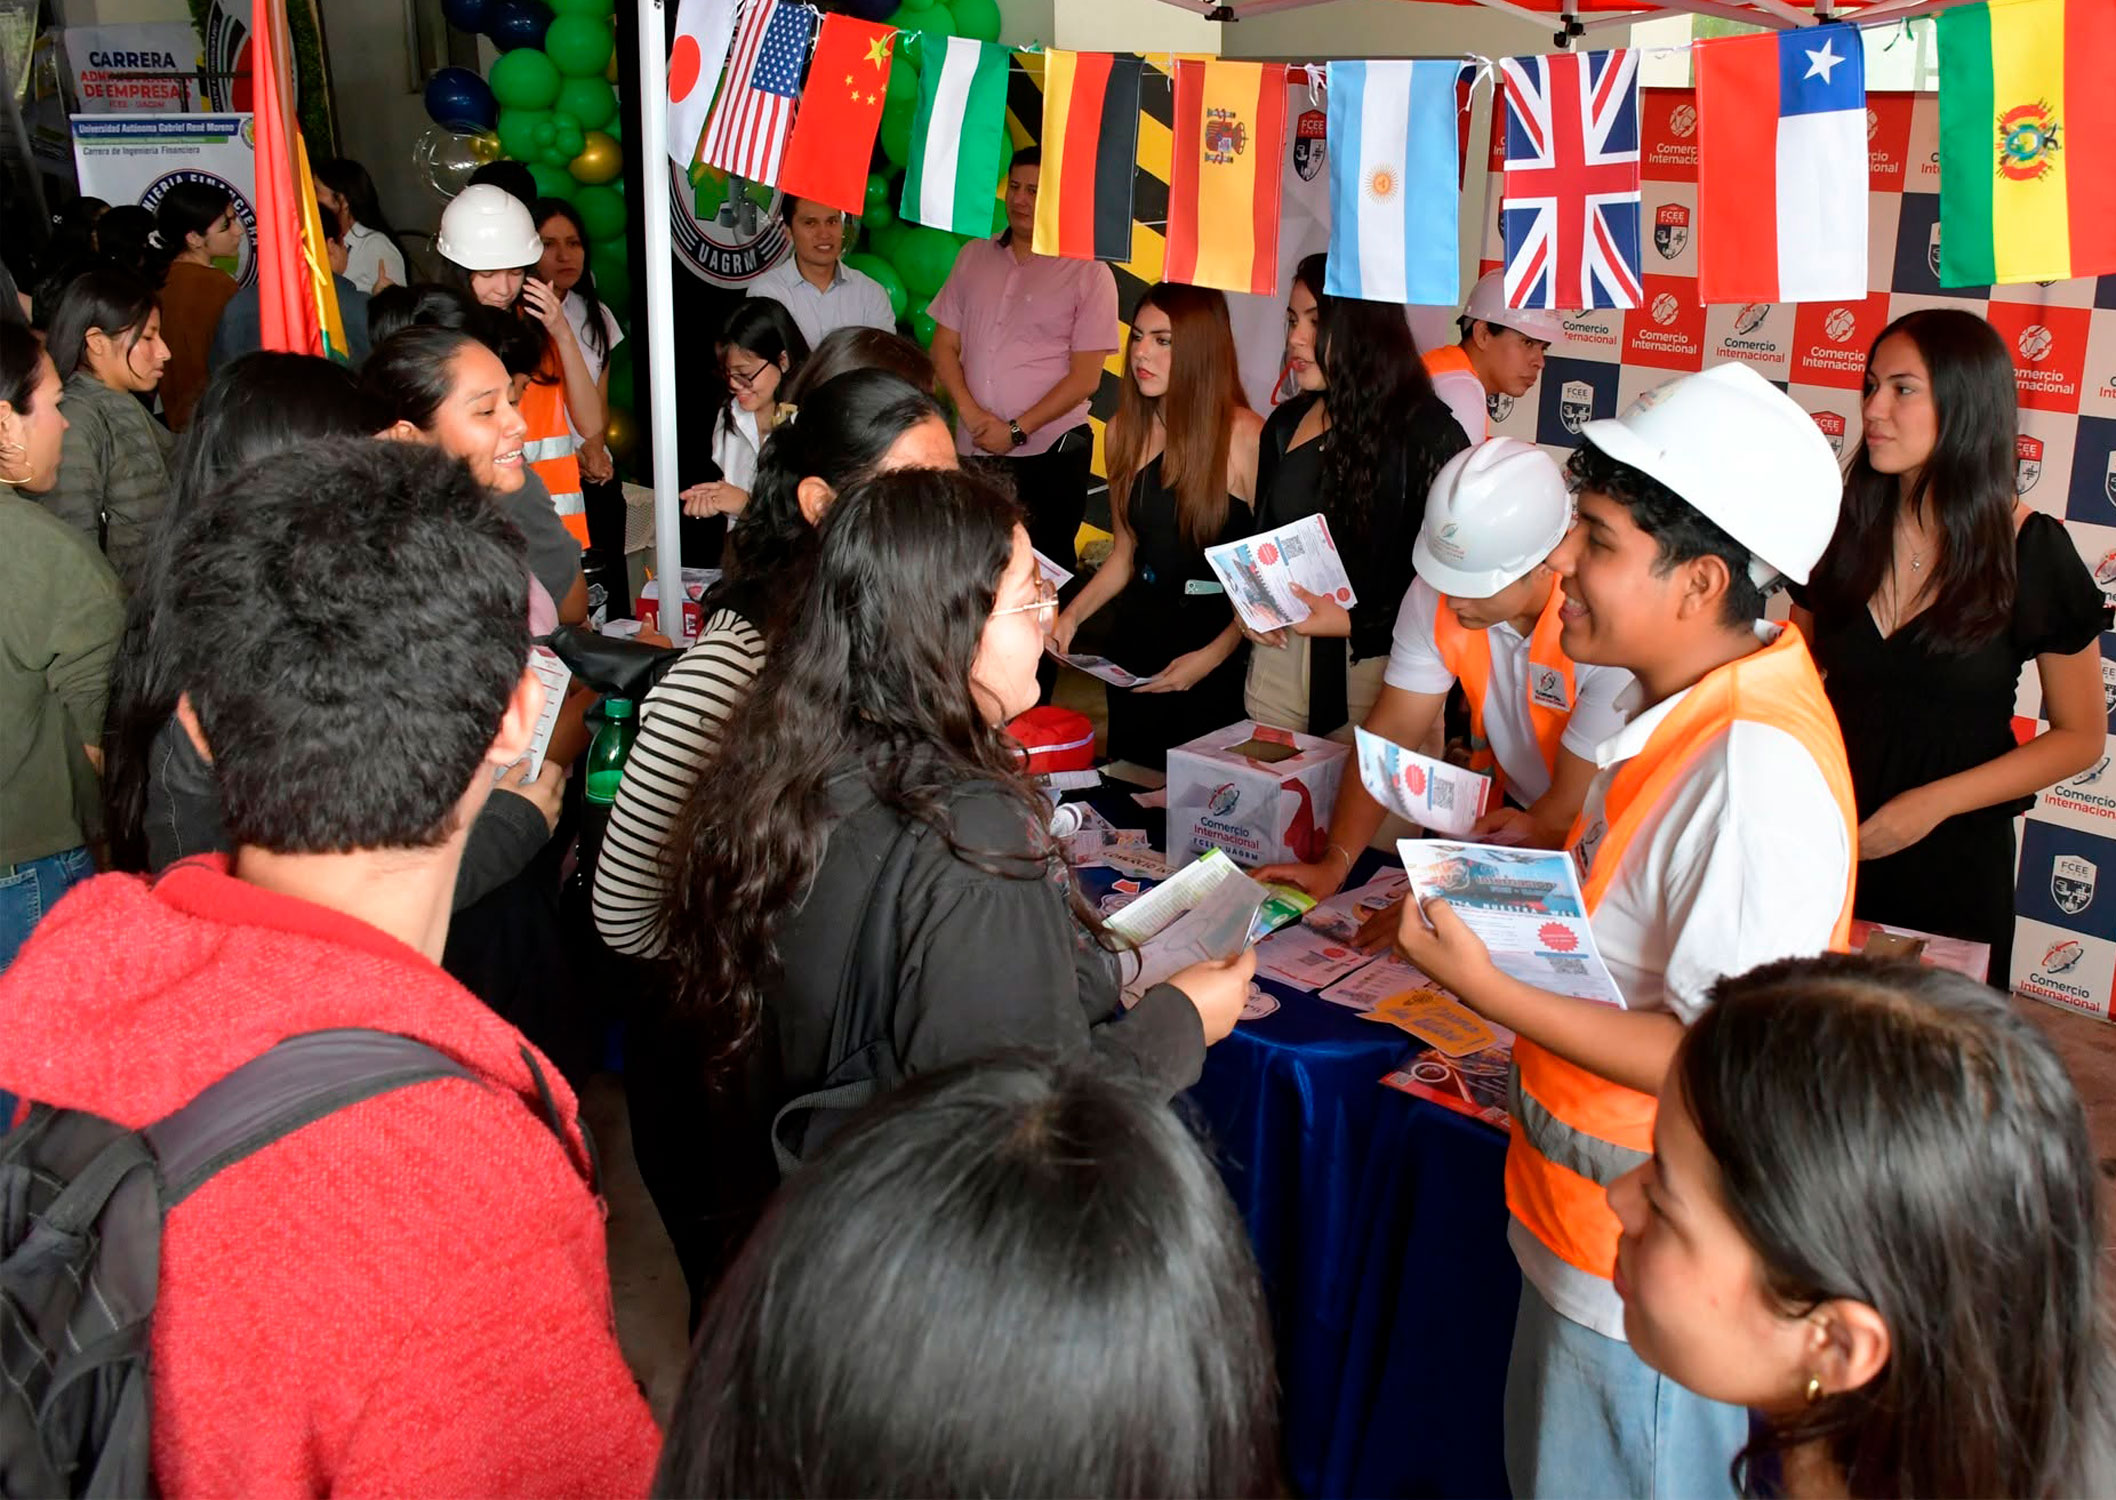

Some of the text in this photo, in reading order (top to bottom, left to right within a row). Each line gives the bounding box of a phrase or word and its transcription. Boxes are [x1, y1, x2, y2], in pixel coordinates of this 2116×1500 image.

[89, 51, 176, 68] CARRERA
[84, 84, 192, 99] DE EMPRESAS
[78, 122, 234, 133] Universidad Autónoma Gabriel René Moreno
[1301, 119, 1325, 130] FCEE
[83, 146, 110, 155] Carrera
[111, 145, 121, 155] de
[160, 145, 200, 154] Financiera
[1656, 143, 1697, 154] Comerc
[1660, 210, 1685, 220] FCEE
[698, 242, 758, 274] UAGRM
[1562, 320, 1609, 334] Comercio
[1564, 331, 1617, 345] ernacional
[1639, 329, 1689, 344] Comercio
[1631, 338, 1697, 355] Internacional
[1724, 337, 1776, 352] Comercio
[1716, 347, 1785, 363] Internacional
[1810, 346, 1866, 361] Comercio
[1802, 356, 1866, 372] Internacion
[1567, 387, 1588, 397] FCEE
[2016, 380, 2075, 395] rnacional
[2016, 442, 2037, 453] CEE
[2054, 785, 2116, 809] Comercio
[2044, 793, 2116, 820] Internacion
[1200, 816, 1250, 838] Comercio
[1194, 824, 1259, 850] Internacional
[2061, 861, 2089, 875] FCEE
[2029, 973, 2090, 998] Comercio
[2020, 980, 2101, 1012] Internacional
